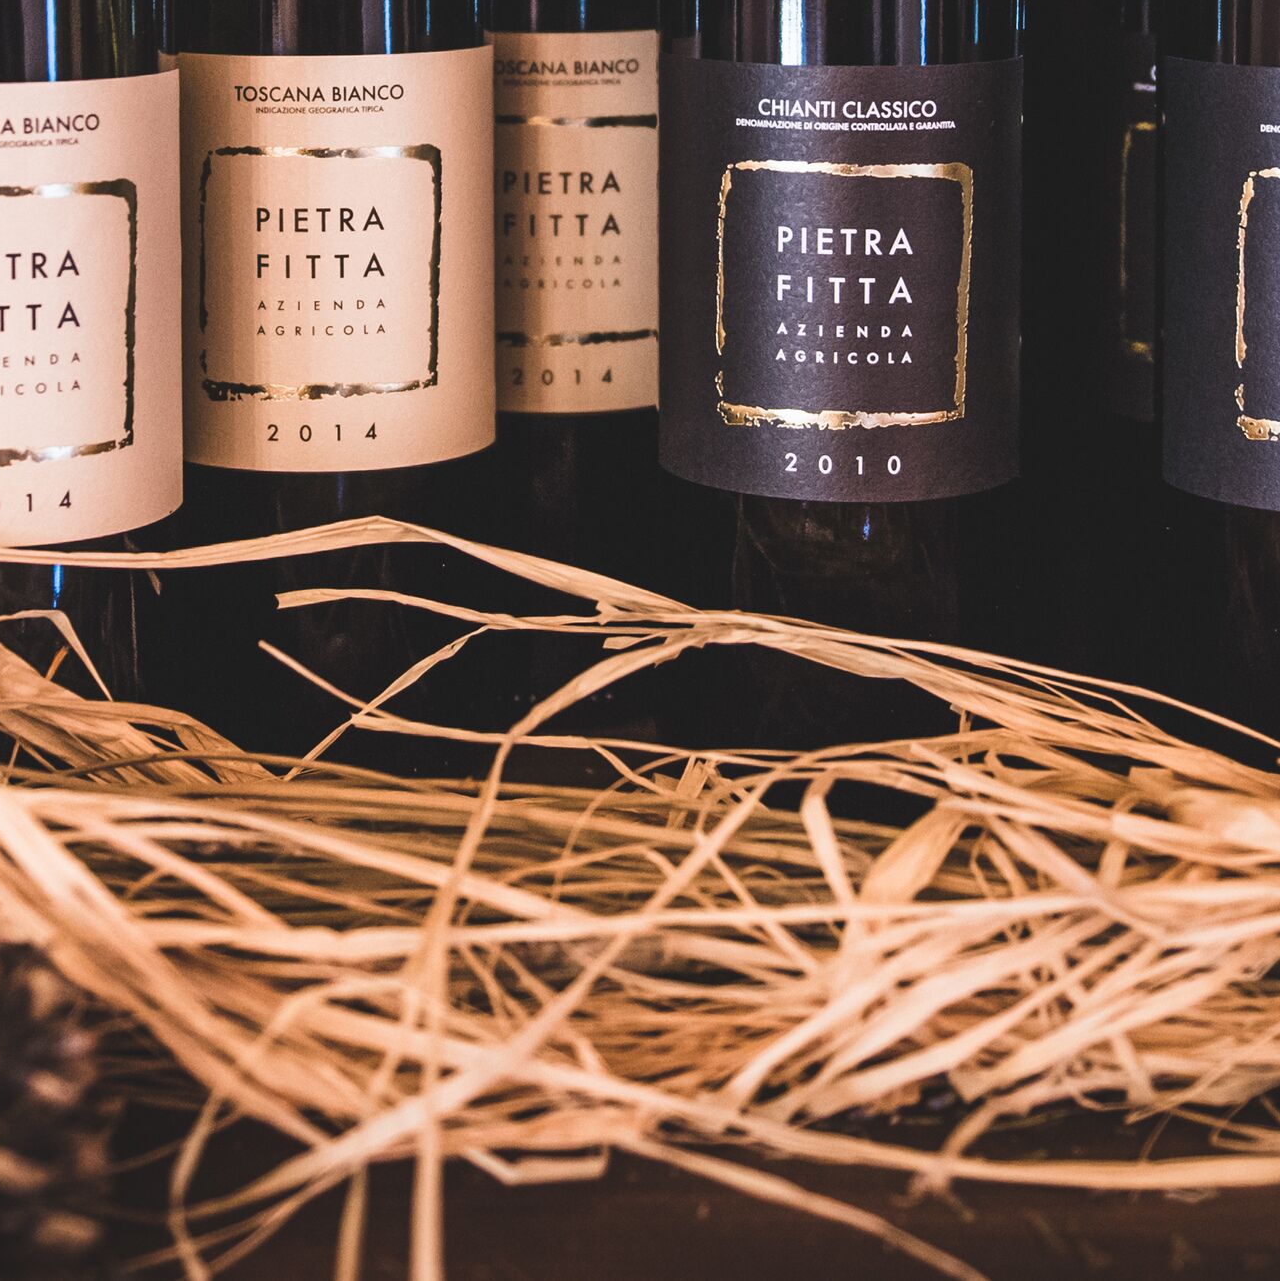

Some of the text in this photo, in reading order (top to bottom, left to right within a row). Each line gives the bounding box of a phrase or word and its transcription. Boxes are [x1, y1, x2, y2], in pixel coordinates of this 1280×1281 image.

[494, 58, 639, 75] OSCANA BIANCO
[234, 84, 404, 102] TOSCANA BIANCO
[308, 106, 359, 114] GEOGRAFICA
[362, 105, 384, 113] TIPICA
[758, 98, 937, 119] CHIANTI CLASSICO
[23, 113, 100, 134] BIANCO
[736, 118, 802, 130] DENOMINAZIONE
[804, 122, 812, 130] DI
[814, 122, 849, 131] ORIGINE
[850, 123, 908, 131] CONTROLLATA
[916, 121, 955, 130] GARANTITA
[504, 170, 621, 194] PIETRA
[255, 205, 385, 232] PIETRA
[504, 214, 621, 236] FITTA
[777, 226, 914, 255] PIETRA
[256, 252, 385, 279] FITTA
[777, 274, 913, 304] FITTA
[257, 298, 386, 311] AZIENDA
[257, 323, 386, 336] AGRICOLA
[776, 323, 913, 339] AZIENDA
[775, 348, 913, 364] AGRICOLA
[512, 368, 613, 385] 2014
[267, 421, 378, 442] 2014
[784, 453, 901, 476] 2010
